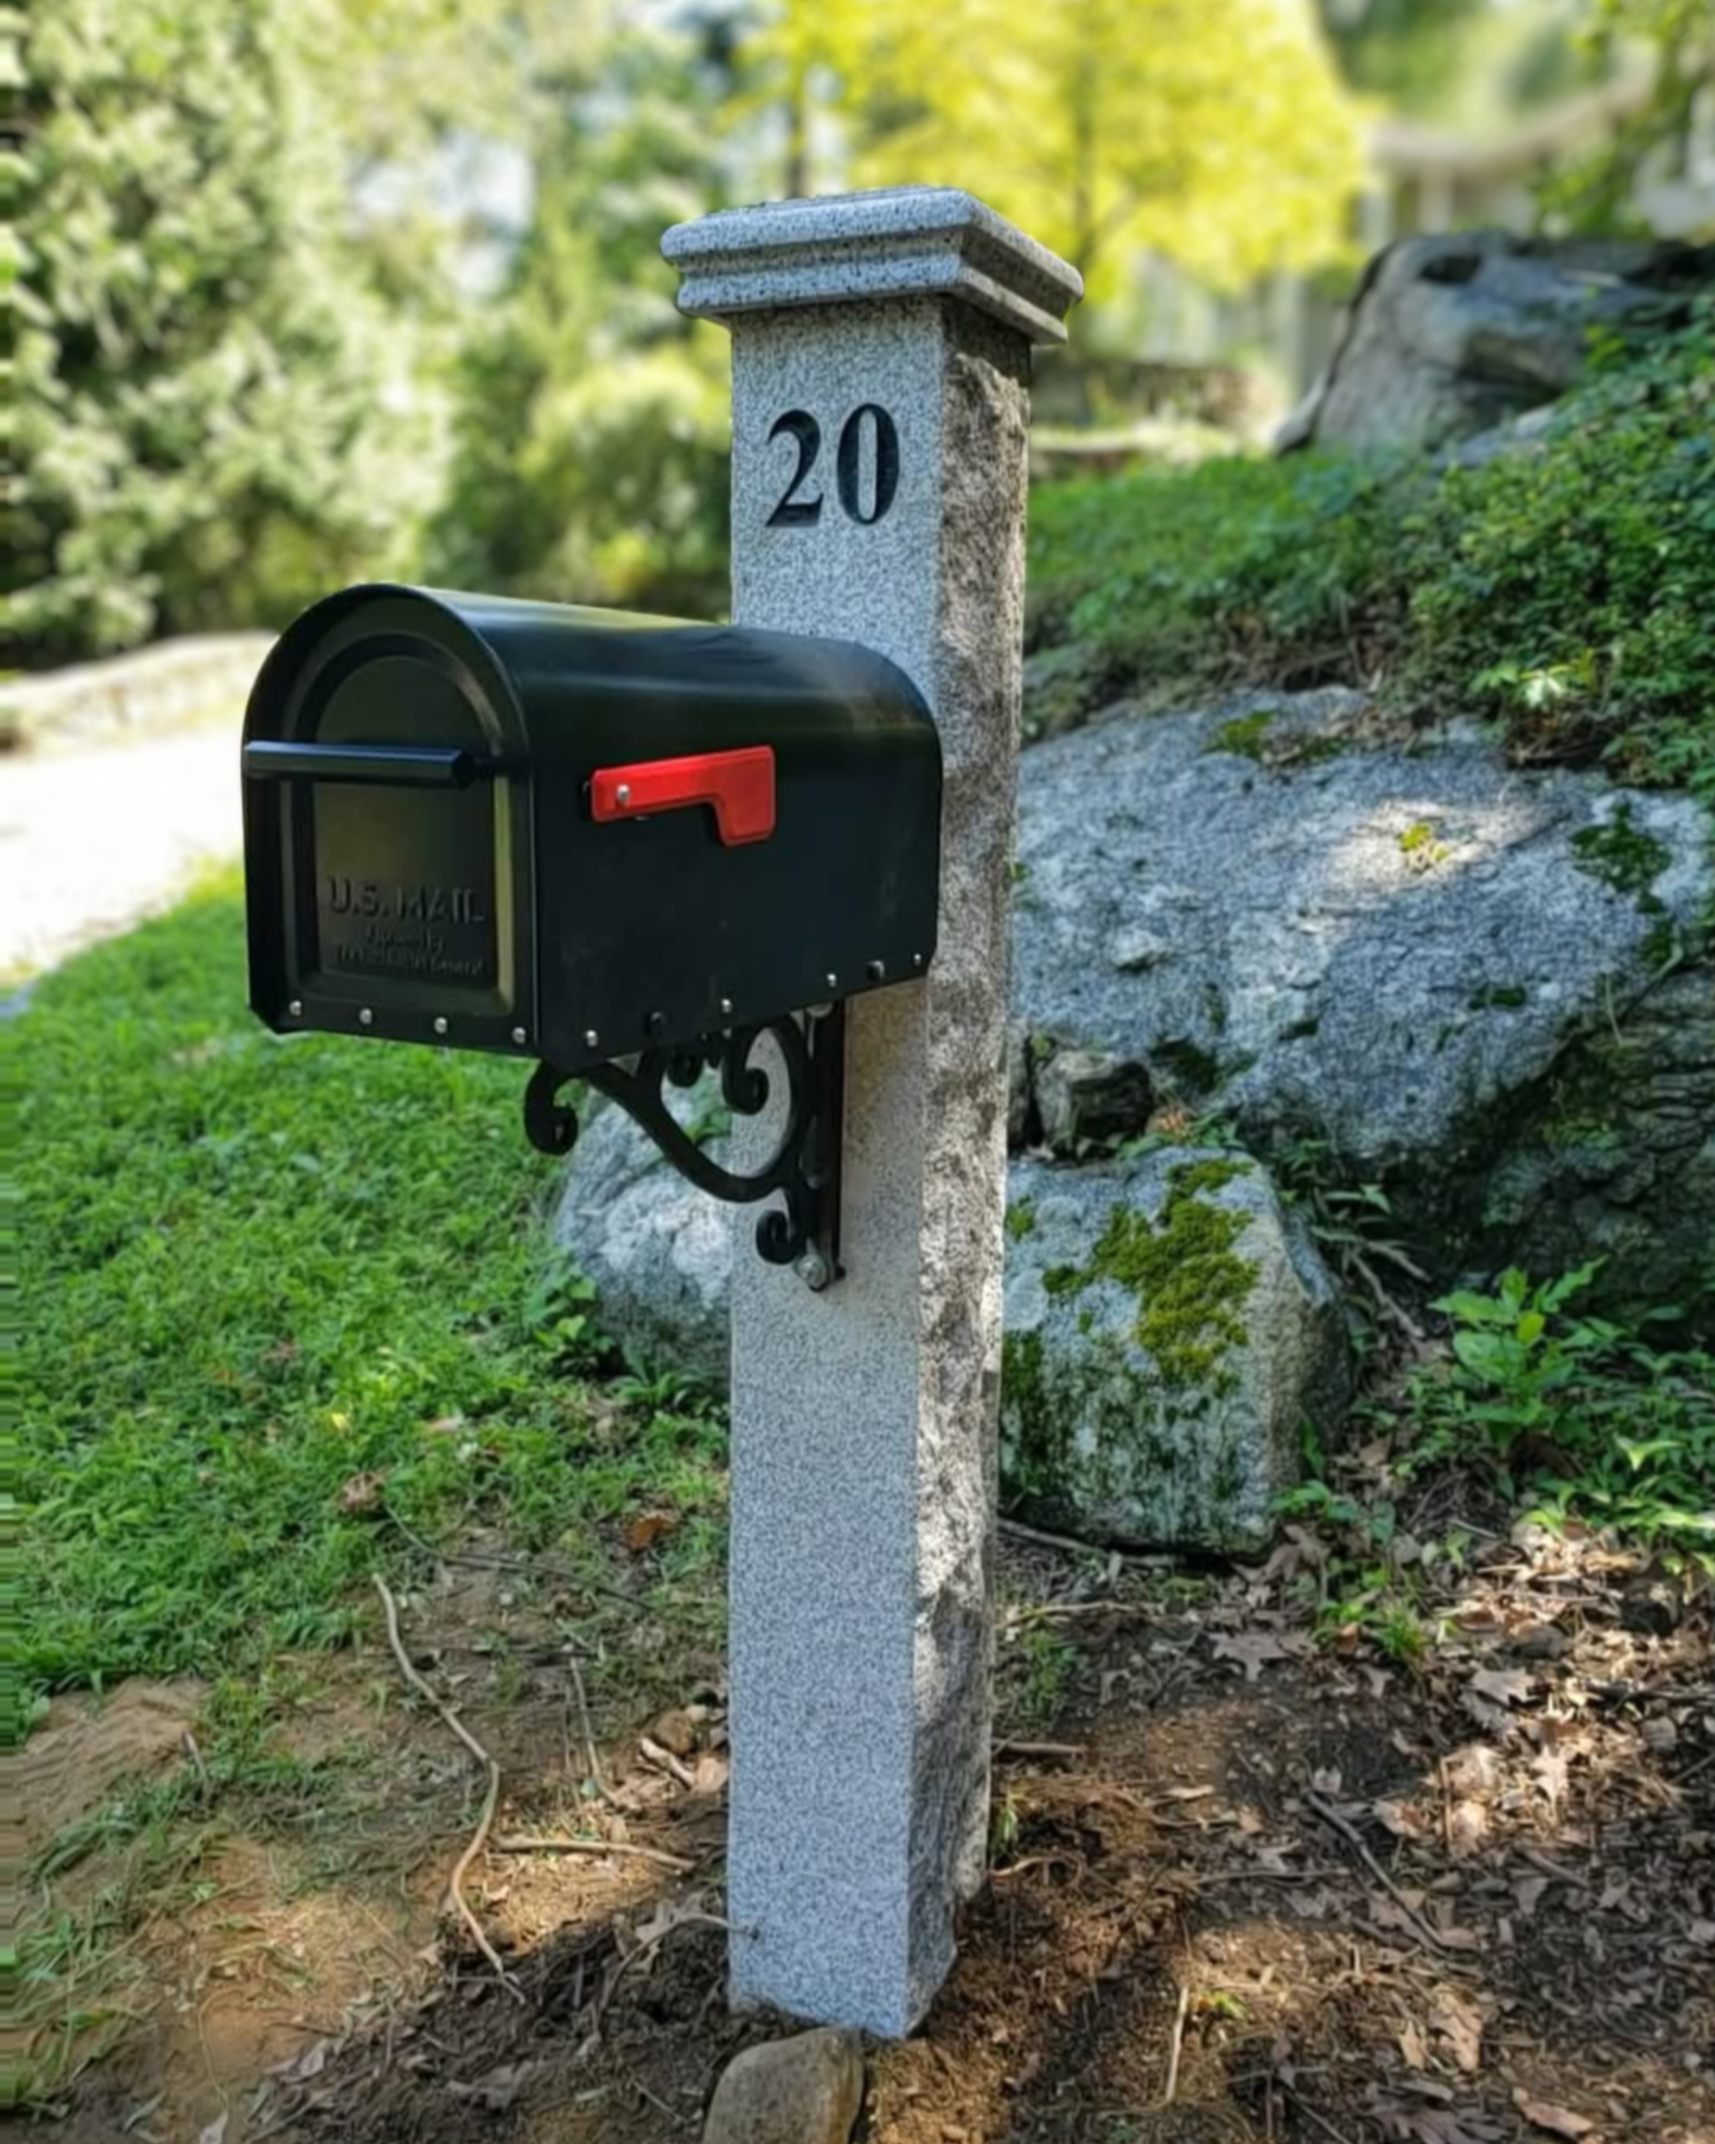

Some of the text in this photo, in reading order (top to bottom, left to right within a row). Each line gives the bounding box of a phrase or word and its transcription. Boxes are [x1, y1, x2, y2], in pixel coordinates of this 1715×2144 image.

[765, 403, 899, 527] 20
[328, 875, 485, 924] U.S. MAIL
